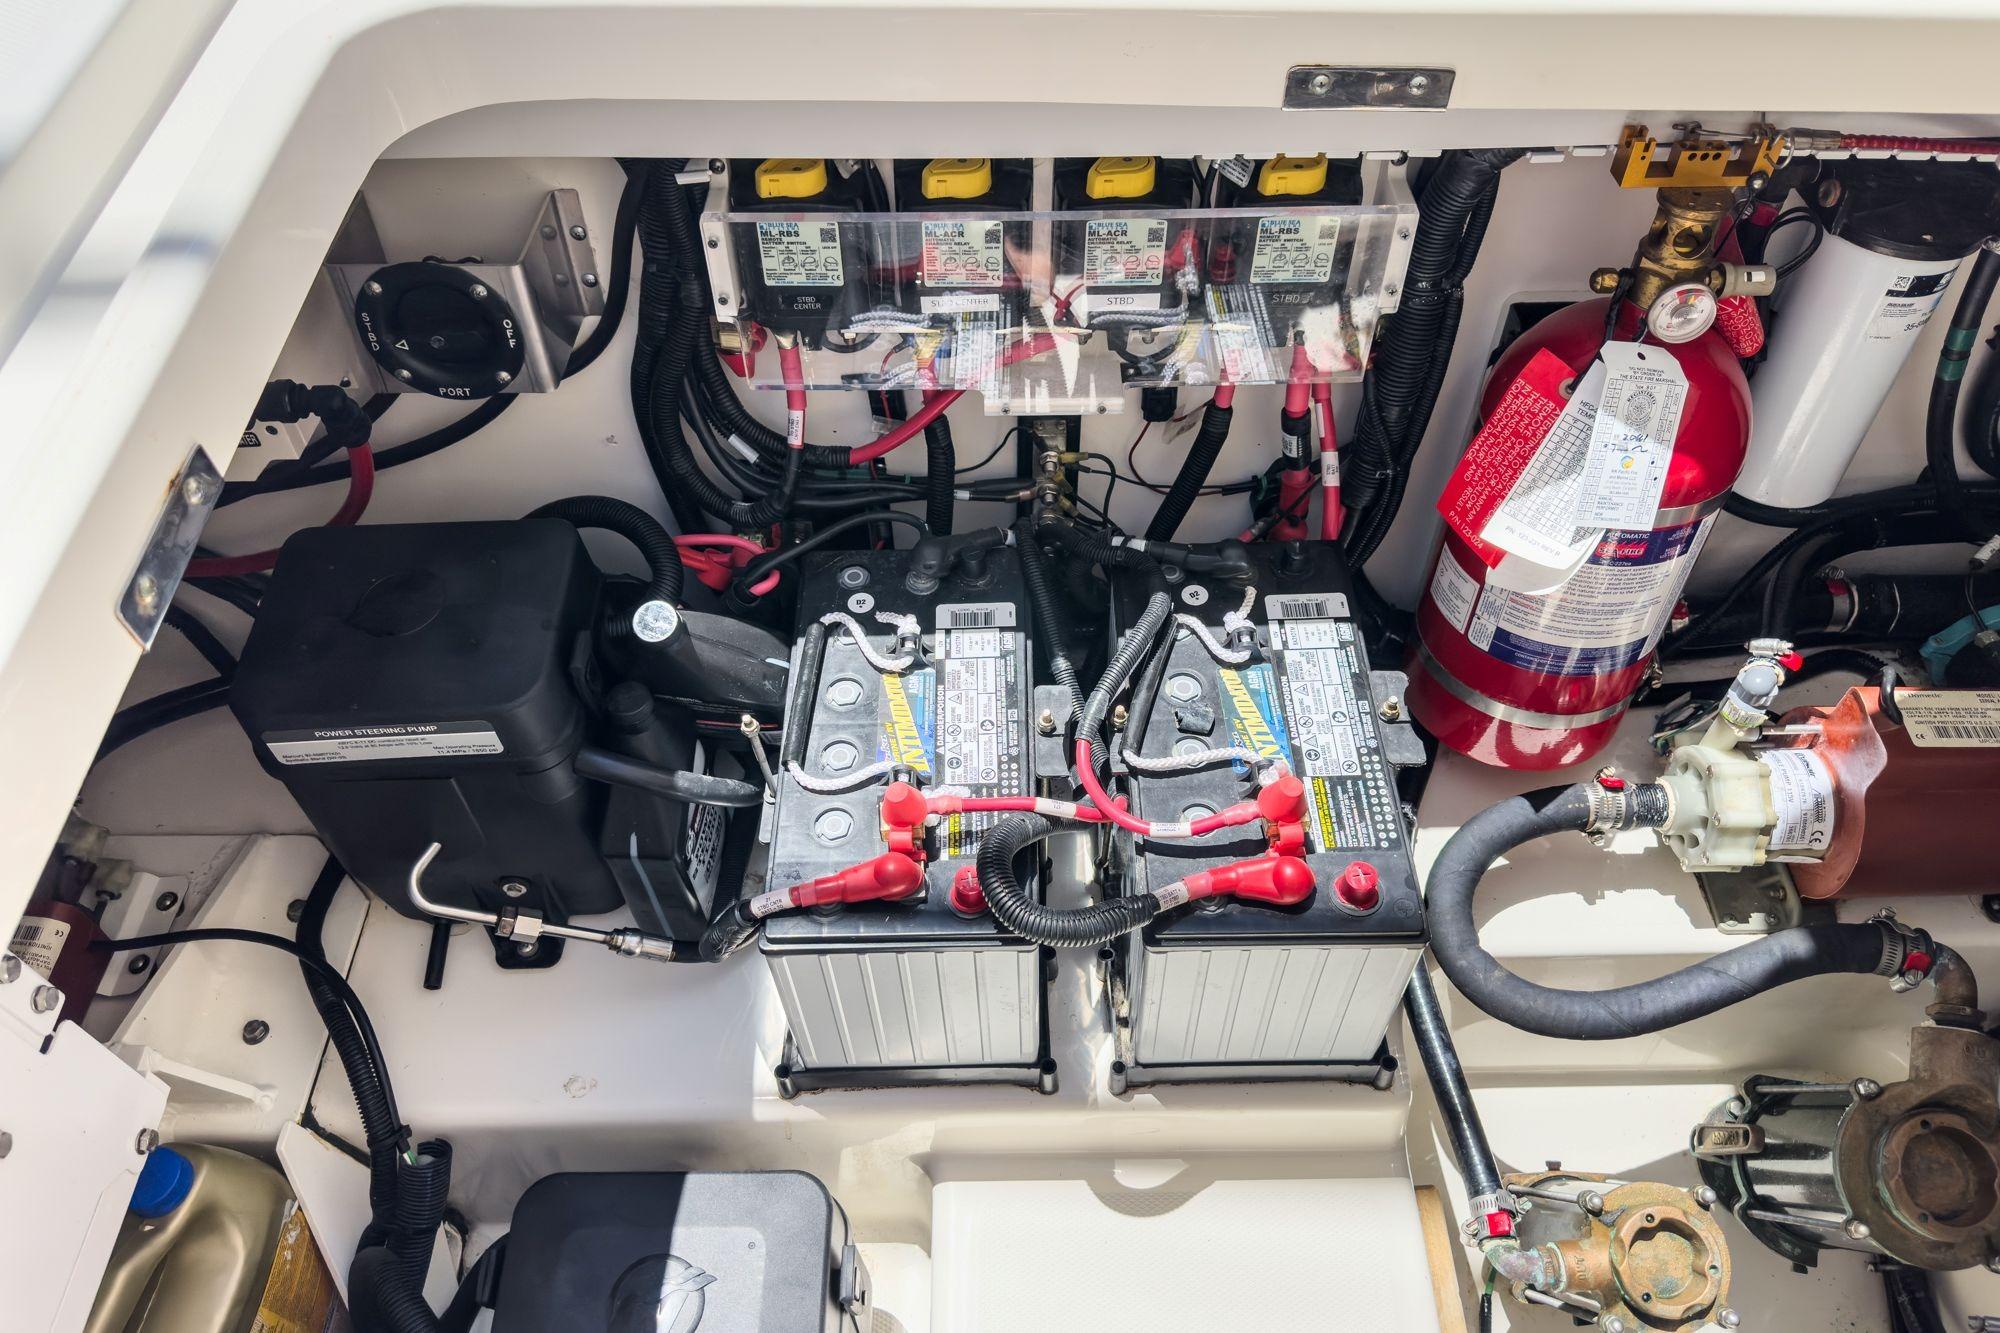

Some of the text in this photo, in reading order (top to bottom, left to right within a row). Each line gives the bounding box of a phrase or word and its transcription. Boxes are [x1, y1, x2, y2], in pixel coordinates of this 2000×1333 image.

[1272, 295, 1300, 304] STBD
[361, 312, 380, 351] STBD
[503, 319, 517, 349] OFF
[439, 387, 471, 397] PORT
[1489, 378, 1525, 425] EQUIPMENT
[1529, 395, 1548, 414] THIS
[1462, 384, 1533, 481] IN PERSONAL INJURY AND
[1519, 406, 1562, 457] ATTEMPTING
[1453, 389, 1540, 511] THESE INSTRUCTIONS MAY RESULT
[1490, 435, 1516, 467] FAILURE
[1496, 438, 1525, 474] OPERATE
[1553, 445, 1561, 453] 30
[1483, 466, 1495, 478] TO
[1510, 456, 1523, 469] TO
[1566, 462, 1577, 470] 320
[1488, 472, 1500, 486] OR
[1463, 477, 1488, 510] FOLLOW
[1464, 485, 1492, 523] MAINTAIN
[1448, 510, 1484, 549] P/N 123-024
[1189, 591, 1200, 599] D2
[1338, 621, 1352, 641] AGM
[908, 674, 922, 695] AGM
[1246, 670, 1261, 690] AGM
[936, 684, 944, 745] DANGER/POISON
[1010, 710, 1016, 719] Pb
[1280, 676, 1300, 738] DANGER/POISON
[1360, 701, 1367, 711] Pb
[355, 727, 406, 736] STEERING
[407, 725, 438, 733] PUMP
[1232, 715, 1244, 730] RV
[757, 903, 769, 911] STBD
